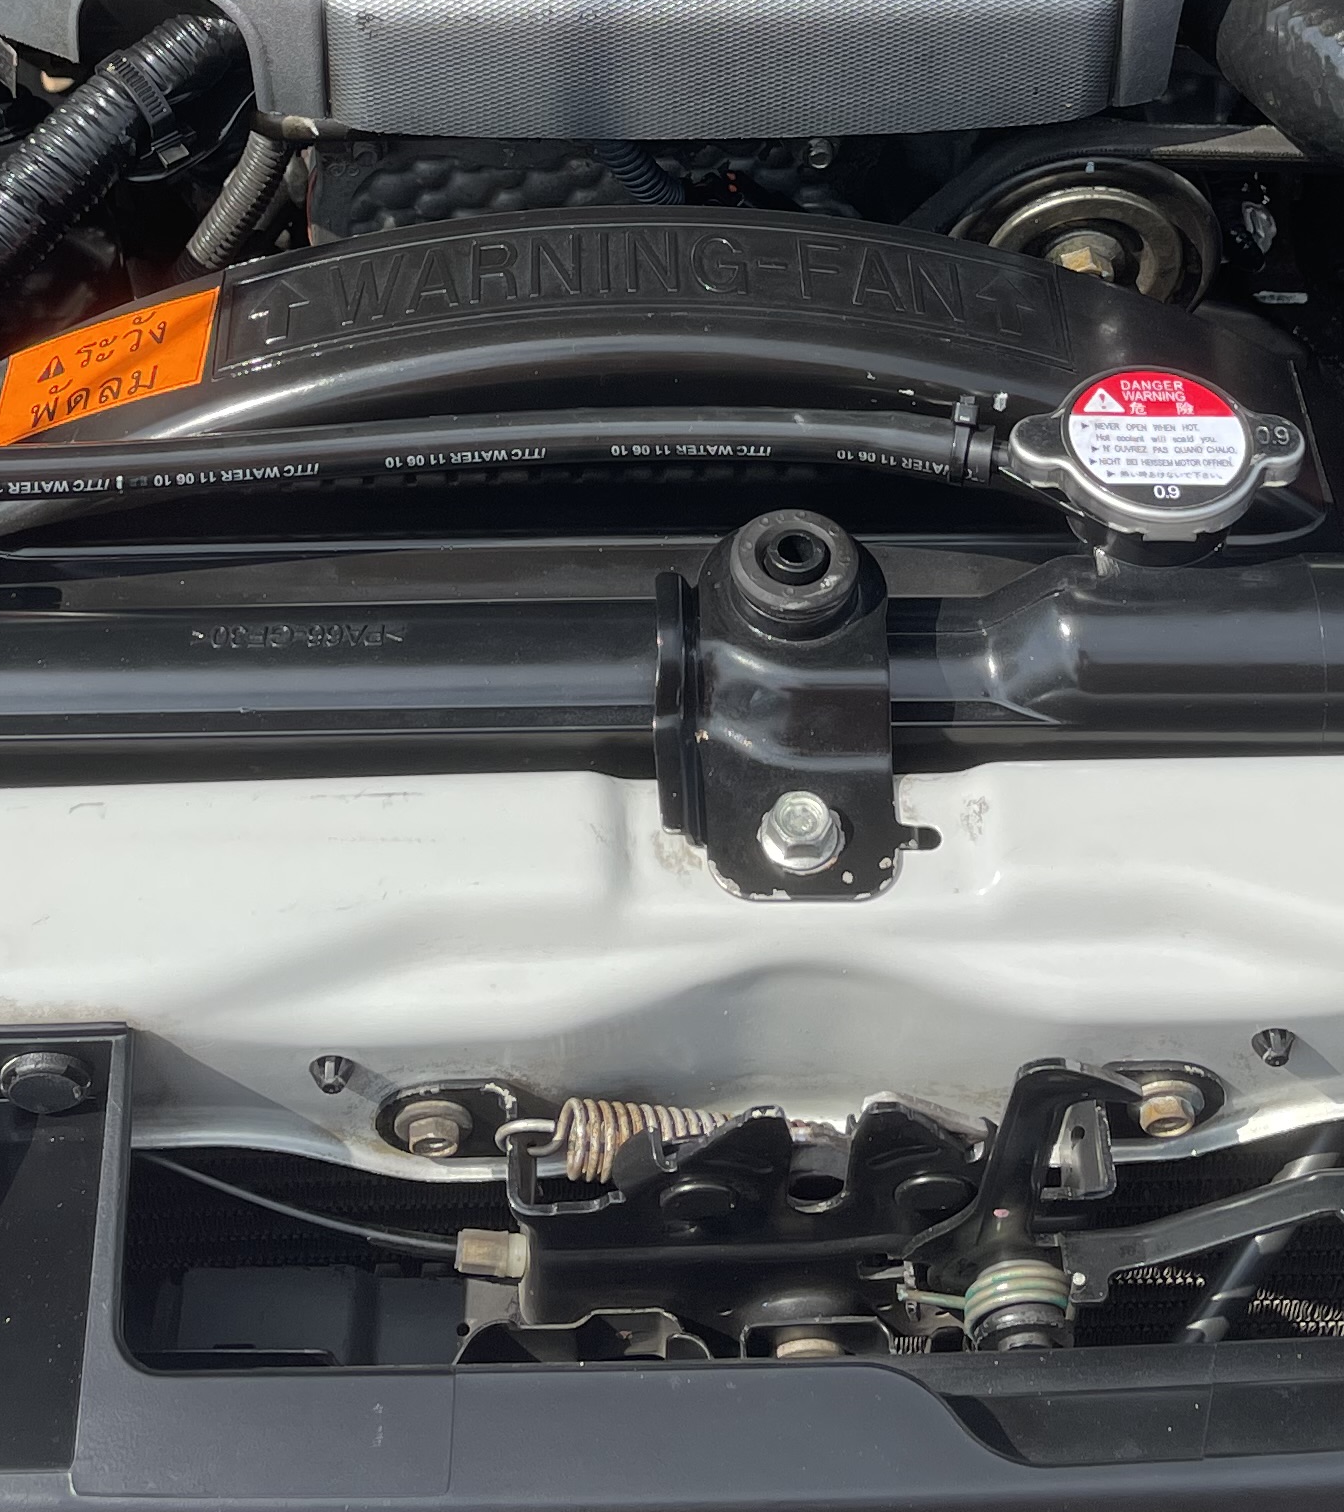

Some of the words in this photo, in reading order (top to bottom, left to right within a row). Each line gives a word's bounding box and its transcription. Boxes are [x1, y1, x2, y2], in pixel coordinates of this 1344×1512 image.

[328, 232, 967, 327] WARNING-FAN
[74, 311, 168, 369] ระวัง
[1120, 380, 1183, 391] DANGER
[30, 365, 159, 429] พัดลม
[1122, 391, 1186, 402] WARNING
[1094, 422, 1120, 432] NEVER
[1126, 423, 1148, 432] OPEN
[1152, 423, 1176, 432] WHEN
[1181, 423, 1201, 432] HOT.
[1095, 434, 1111, 442] Hot
[1116, 434, 1145, 443] coolant
[1151, 434, 1167, 443] will
[1172, 434, 1195, 443] scald
[1255, 426, 1290, 445] 0.9
[510, 447, 547, 461] ITTC
[610, 444, 630, 457] 10
[631, 444, 652, 457] 06
[654, 444, 672, 456] 11
[675, 443, 734, 457] WATER
[736, 444, 773, 457] ITTC
[836, 449, 855, 461] 10
[857, 450, 877, 463] 06
[1114, 445, 1148, 454] OUVREZ
[1152, 445, 1169, 454] PAS
[384, 455, 404, 470] 10
[406, 454, 426, 468] 06
[429, 453, 447, 467] 11
[449, 449, 509, 466] WATER
[880, 453, 898, 467] 11
[1099, 457, 1121, 466] NICHT
[1174, 458, 1202, 467] MOTOR
[220, 467, 281, 483] WATER
[282, 462, 320, 477] ITTC
[152, 473, 173, 487] 10
[175, 472, 197, 486] 06
[198, 471, 218, 484] 11
[7, 480, 70, 494] WATER
[72, 478, 111, 492] ITTC
[1152, 485, 1182, 500] 0.9
